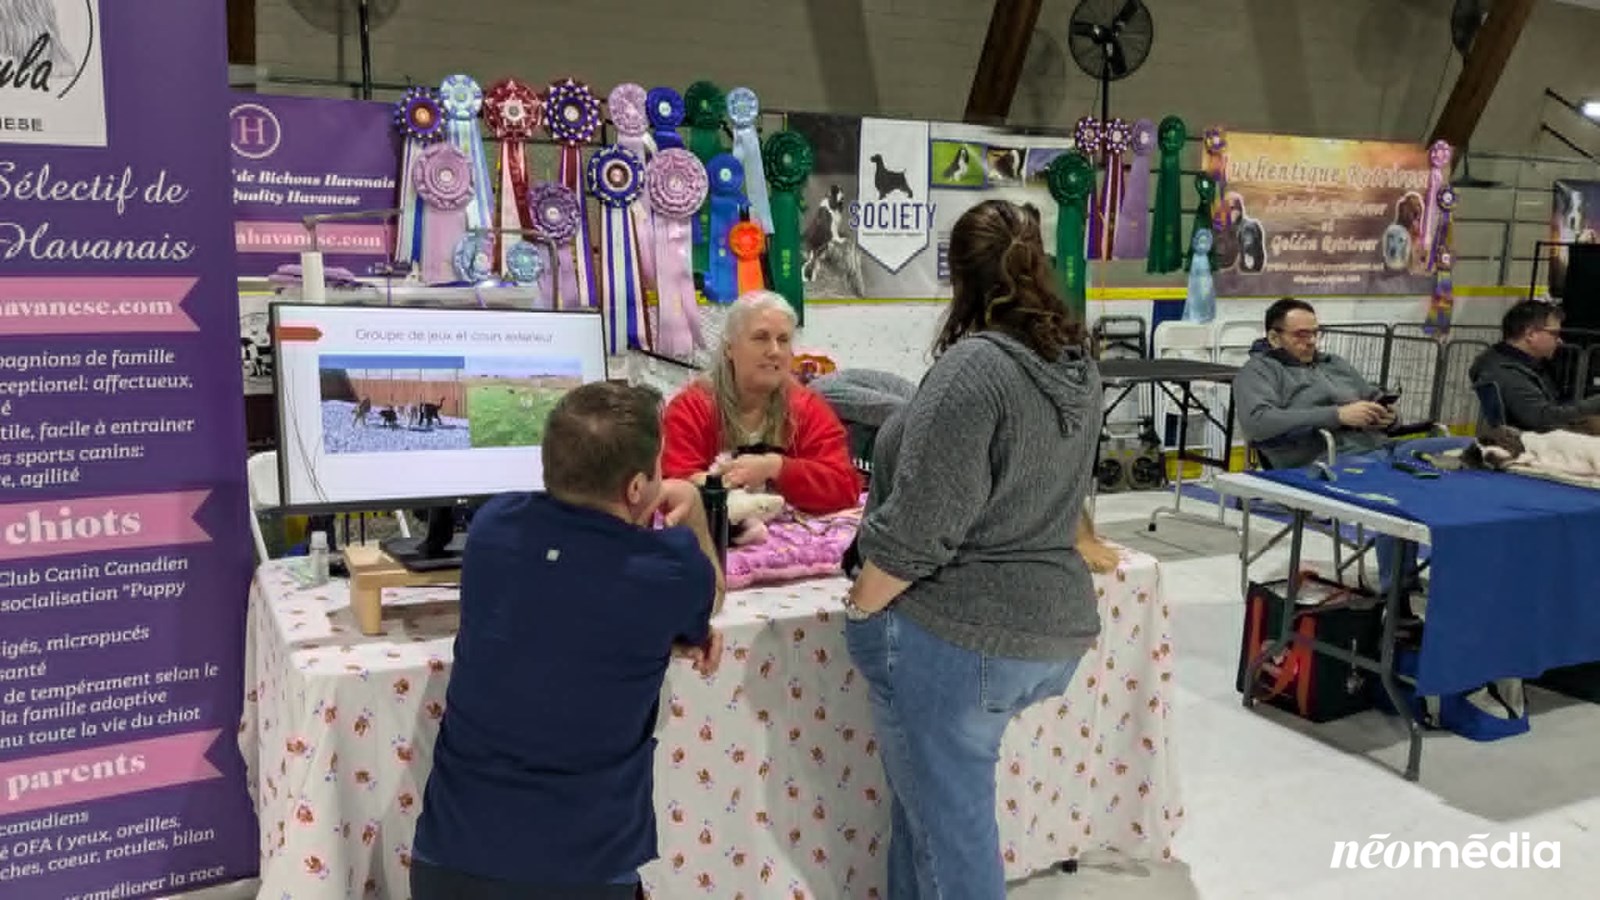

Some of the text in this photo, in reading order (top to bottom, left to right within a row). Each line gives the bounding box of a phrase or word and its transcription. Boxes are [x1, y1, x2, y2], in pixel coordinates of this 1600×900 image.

[0, 117, 44, 132] ESE
[239, 116, 266, 145] H
[144, 169, 190, 204] de
[258, 171, 321, 186] Bichons
[324, 174, 395, 189] Havanais
[849, 202, 937, 230] SOCIETY
[235, 227, 382, 248] ahavanse.com
[85, 350, 108, 366] de
[112, 348, 176, 369] famille
[40, 419, 91, 442] facile
[16, 448, 75, 467] sports
[20, 467, 80, 488] agilité
[5, 506, 142, 545] chiots
[0, 556, 188, 587] Club Canin Canadien
[0, 587, 118, 612] socialisation
[47, 624, 151, 650] micropucés
[4, 662, 219, 704] de tempérament selon le
[22, 701, 86, 726] famille
[90, 691, 168, 714] adoptive
[28, 727, 76, 745] toute
[81, 721, 97, 736] la
[101, 718, 127, 732] vie
[131, 713, 153, 728] du
[157, 708, 201, 724] chiot
[6, 753, 147, 801] parents
[13, 838, 53, 858] OFA
[173, 828, 215, 847] bilan
